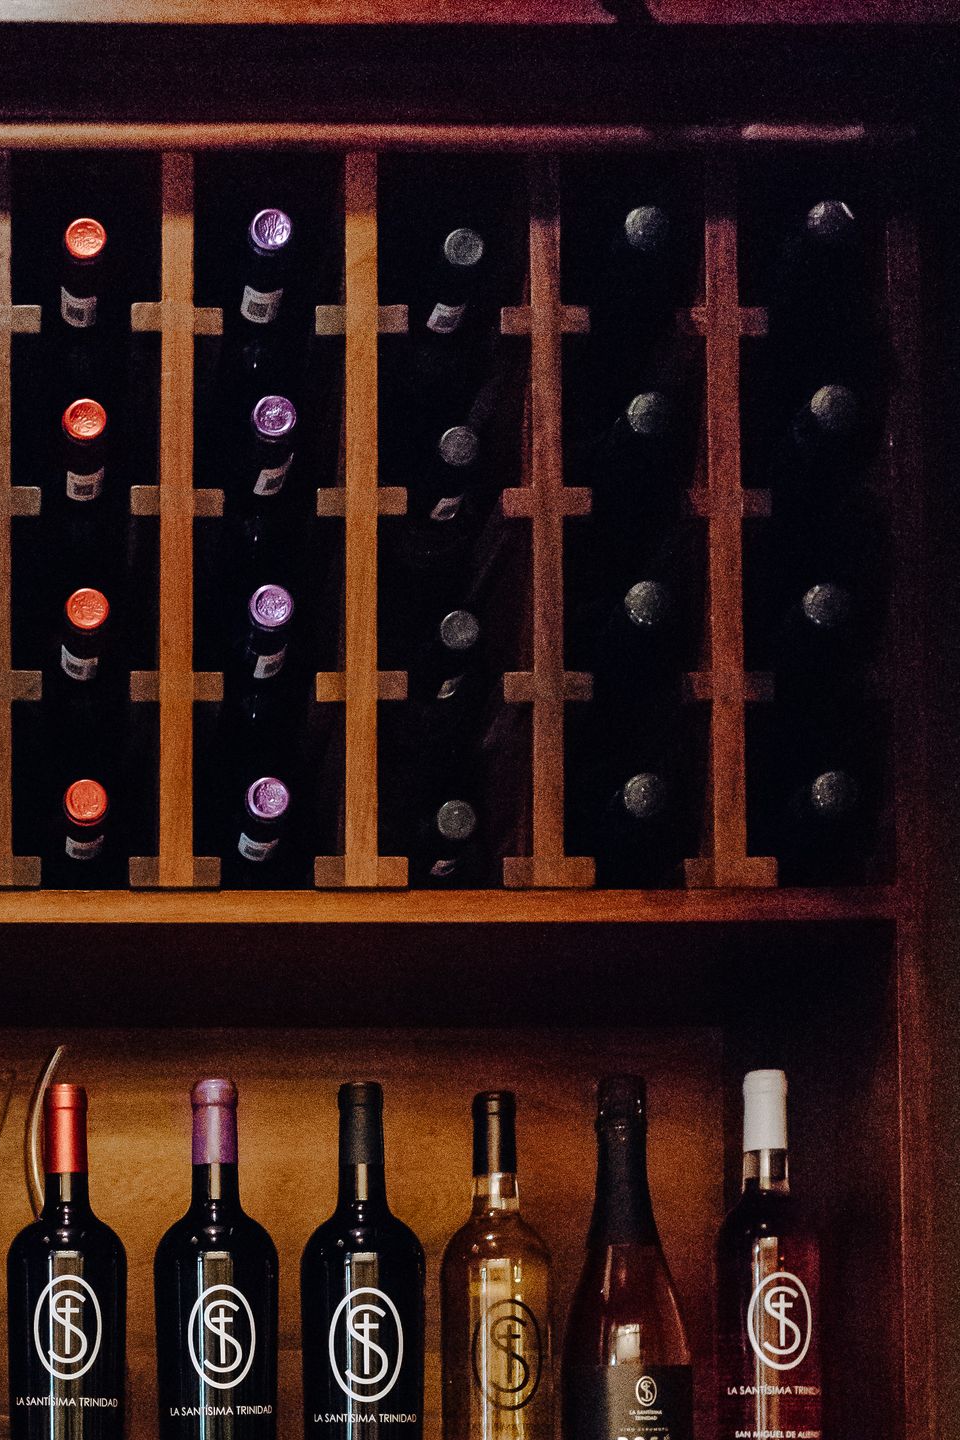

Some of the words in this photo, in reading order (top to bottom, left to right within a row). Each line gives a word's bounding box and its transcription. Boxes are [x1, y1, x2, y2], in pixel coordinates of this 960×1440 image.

[727, 1387, 738, 1396] LA
[16, 1397, 25, 1406] LA
[79, 1398, 118, 1407] TRINIDAD
[170, 1407, 180, 1416] LA
[236, 1405, 273, 1415] TRINIDAD
[313, 1413, 323, 1423] LA
[379, 1413, 417, 1423] TRINIDAD
